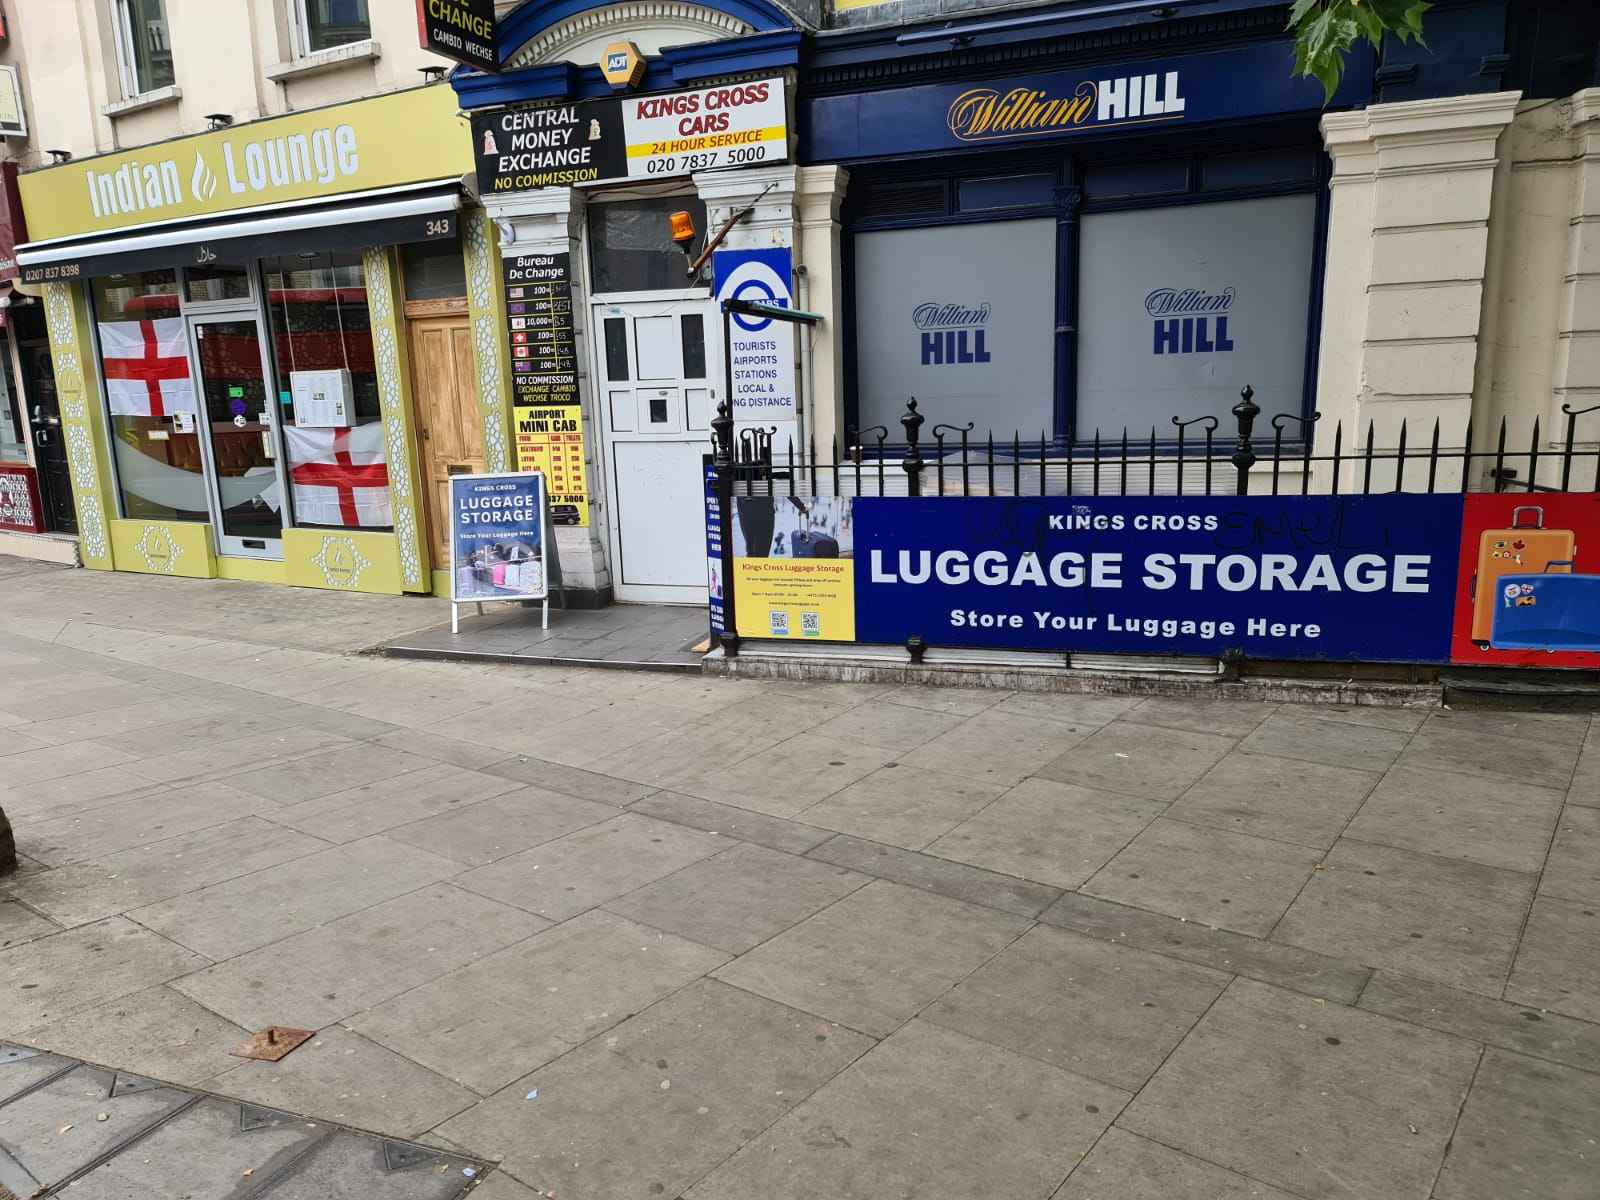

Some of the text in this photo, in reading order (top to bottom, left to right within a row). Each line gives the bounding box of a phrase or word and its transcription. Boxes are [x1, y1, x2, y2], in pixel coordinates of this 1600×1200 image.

[428, 0, 493, 41] CHANGE
[433, 28, 493, 62] CAMBIO WECHSE
[608, 55, 626, 70] ADT
[636, 82, 770, 120] KINGS CROSS
[948, 72, 1185, 141] William HILL
[501, 106, 580, 131] CENTRAL
[678, 112, 730, 137] CARS
[512, 127, 574, 151] MONEY
[651, 129, 763, 155] 24 HOUR SERVICE
[498, 146, 592, 172] EXCHANGE
[647, 145, 766, 174] 020 7837 5000
[86, 124, 359, 218] Indian Lounge
[494, 167, 599, 190] NO COMMISSION
[426, 218, 449, 236] 343
[516, 256, 554, 267] Bureau
[45, 266, 60, 279] 837
[509, 267, 564, 280] De Change
[1144, 286, 1236, 317] William
[1153, 316, 1234, 355] HILL
[734, 340, 777, 351] TOURISTS
[921, 329, 991, 366] HILL
[733, 355, 778, 365] AIRPORTS
[516, 375, 574, 385] NO COMMISSION
[734, 369, 778, 380] STATIONS
[518, 384, 577, 393] EXCHANGE CAMBIO
[737, 384, 775, 393] LOCAL &
[733, 397, 792, 408] NG DISTANCE
[528, 409, 566, 420] AIRPORT
[520, 420, 578, 432] MINI CAB
[460, 495, 534, 510] LUGGAGE
[460, 509, 534, 524] STORAGE
[1048, 514, 1125, 531] KINGS
[1133, 514, 1219, 531] CROSS
[816, 564, 845, 574] Storage
[870, 549, 1432, 594] LUGGAGE STORAGE
[950, 609, 1322, 639] Store Your Luggage Here
